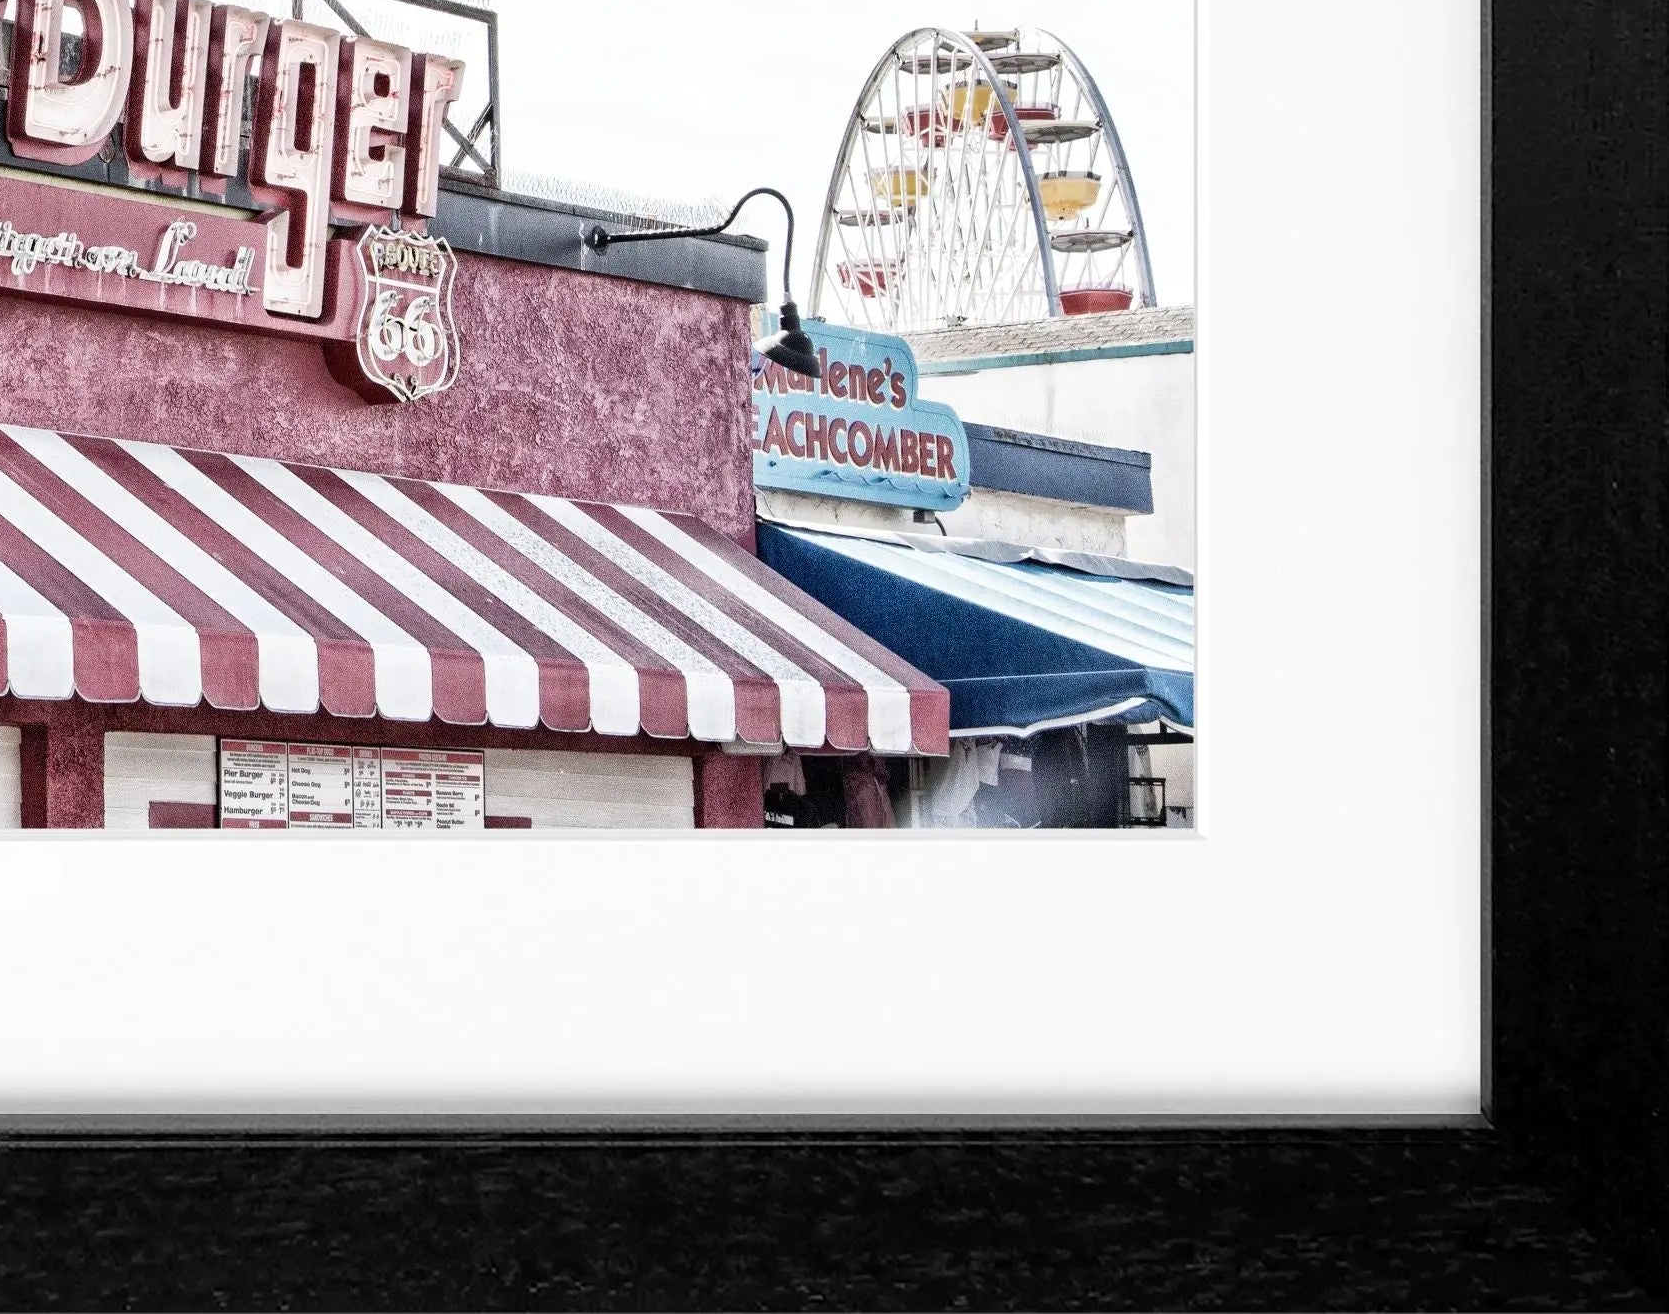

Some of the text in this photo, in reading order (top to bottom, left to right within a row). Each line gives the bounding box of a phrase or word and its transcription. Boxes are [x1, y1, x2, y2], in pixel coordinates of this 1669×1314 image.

[370, 290, 444, 368] 66
[223, 769, 238, 778] Pier
[239, 770, 264, 780] Burger
[300, 768, 311, 776] Dog
[310, 781, 322, 789] Dog
[223, 789, 248, 800] Veggie
[249, 790, 274, 801] Burger
[223, 806, 264, 817] Hamburger
